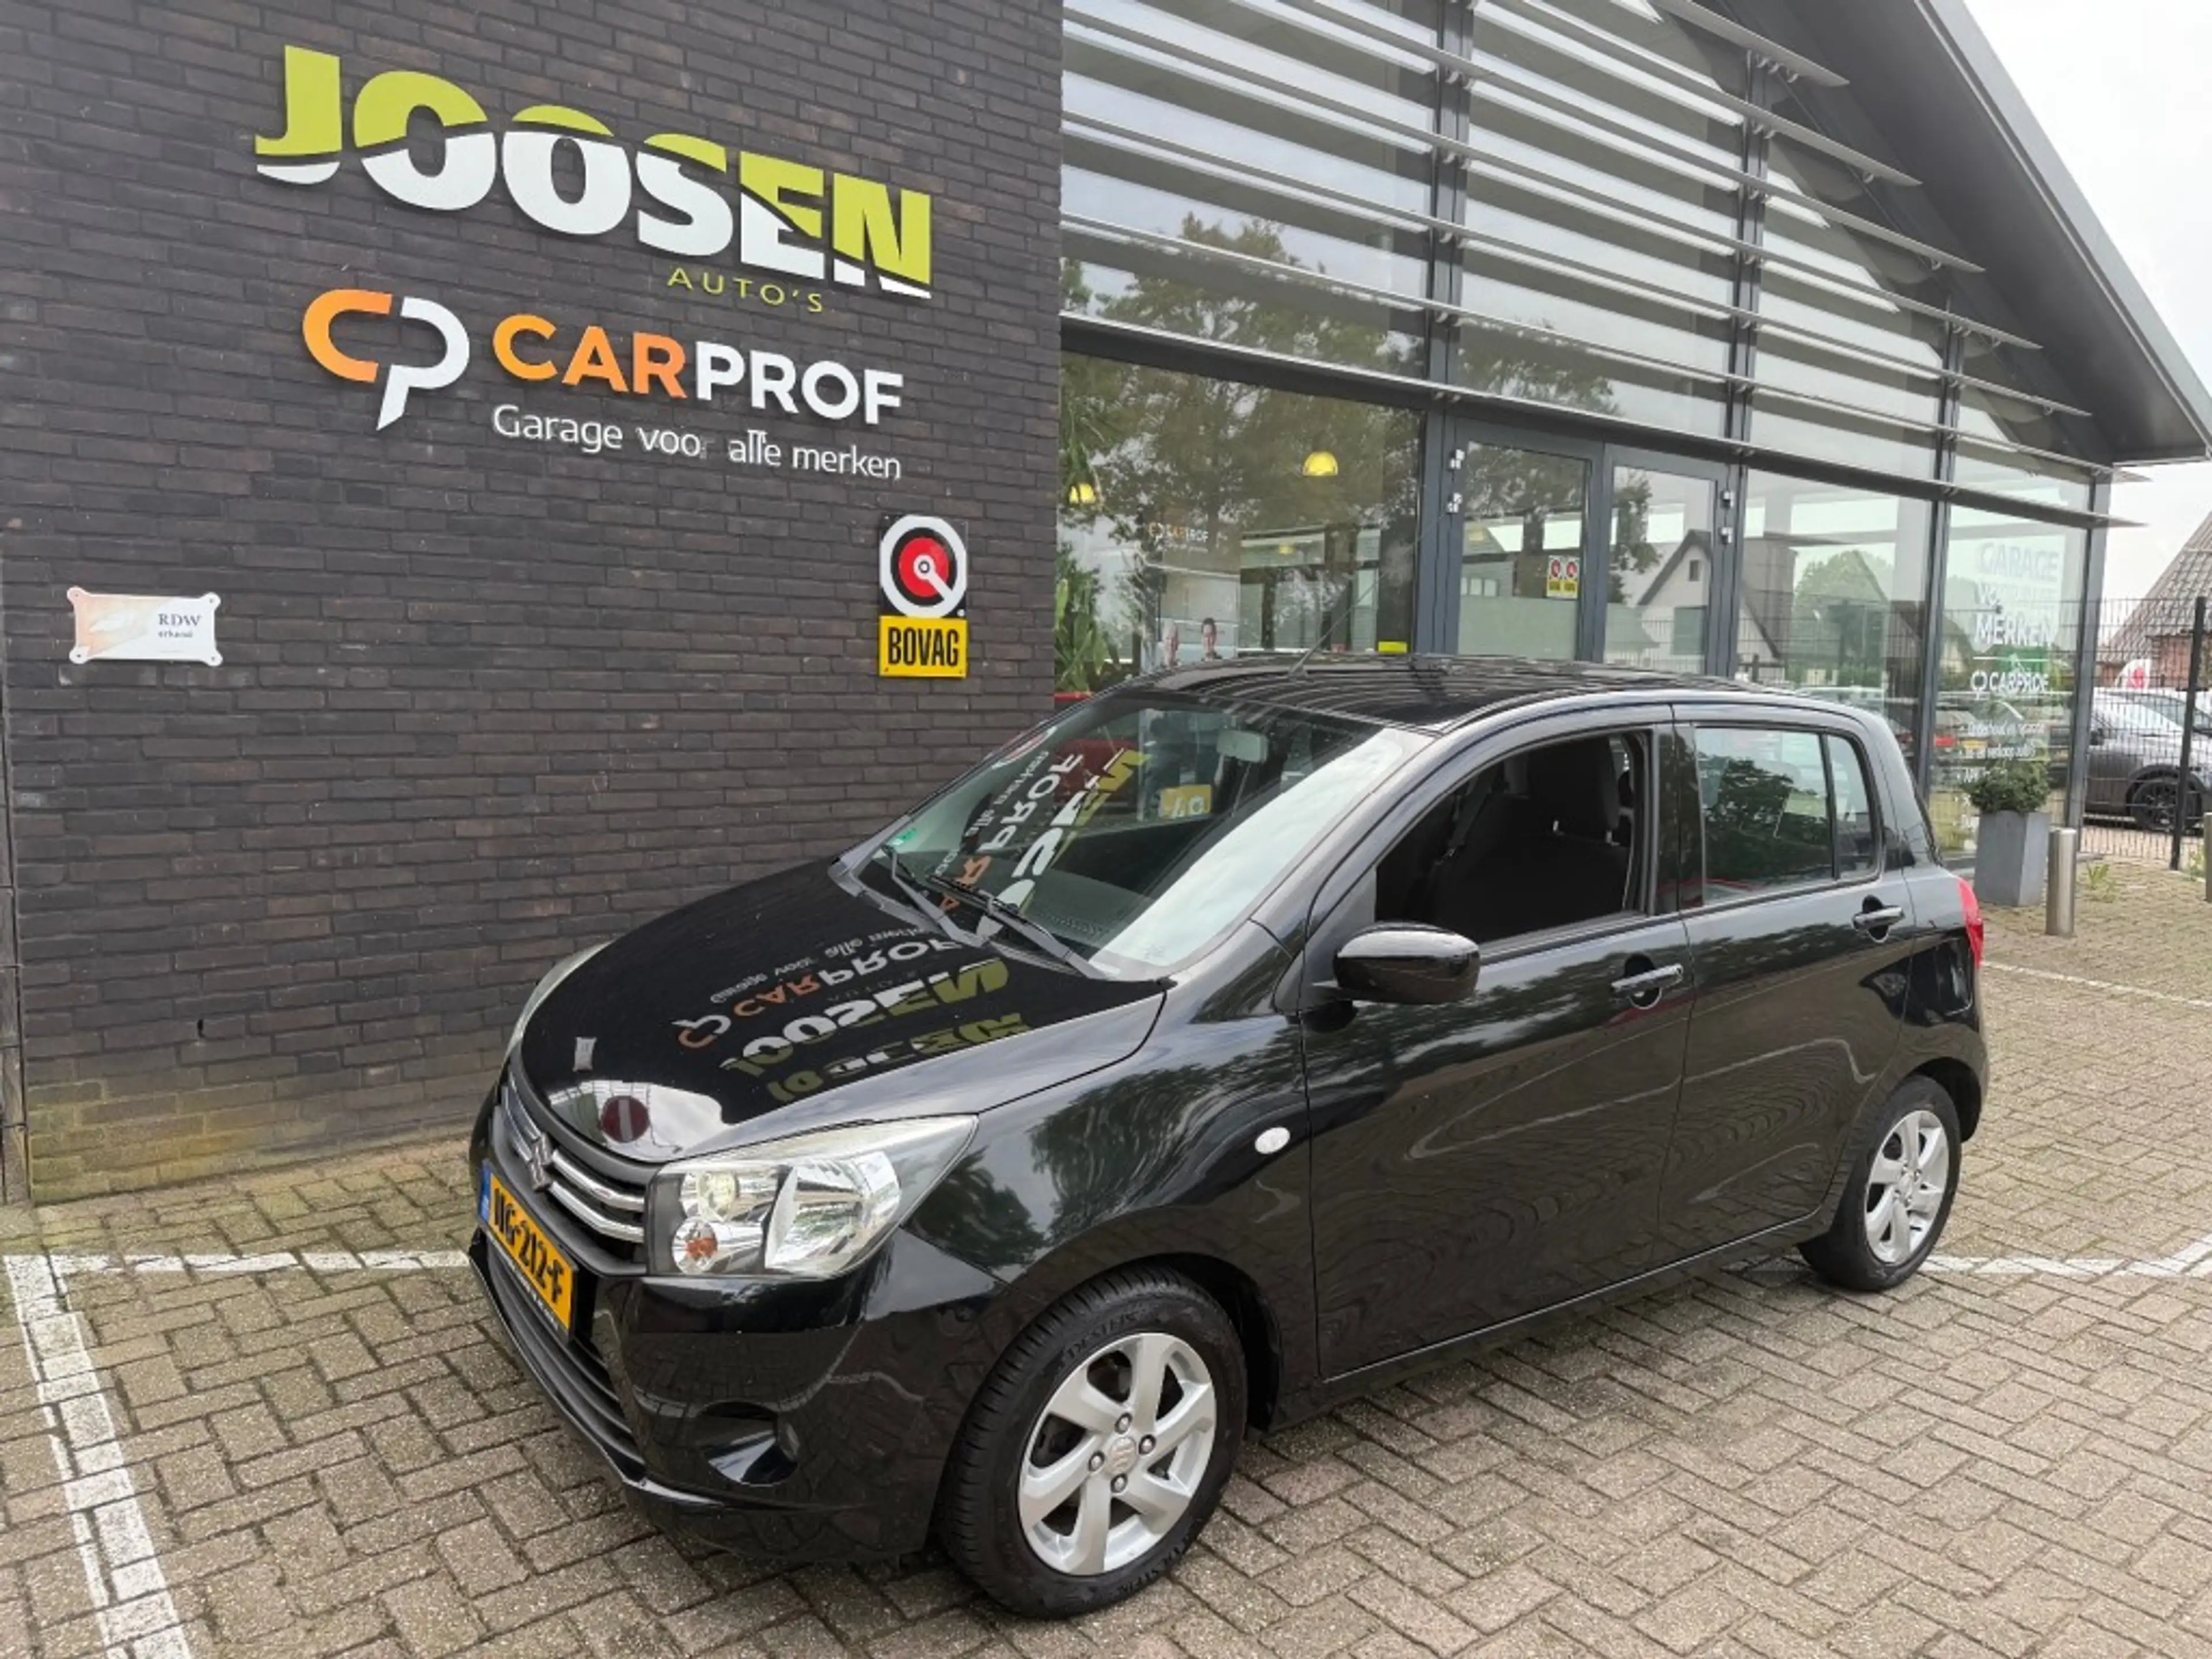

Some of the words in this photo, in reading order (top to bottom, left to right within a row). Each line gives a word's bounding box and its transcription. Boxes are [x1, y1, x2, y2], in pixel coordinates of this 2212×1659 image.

[255, 45, 933, 299] JOOSEN
[667, 268, 823, 312] AUTO'S
[493, 314, 904, 425] CARPROF
[493, 404, 623, 453] Garage
[728, 429, 781, 465] alle
[792, 444, 902, 480] merken
[158, 613, 202, 627] RDW
[1975, 611, 2056, 647] MERKEN
[887, 626, 959, 667] BOVAG
